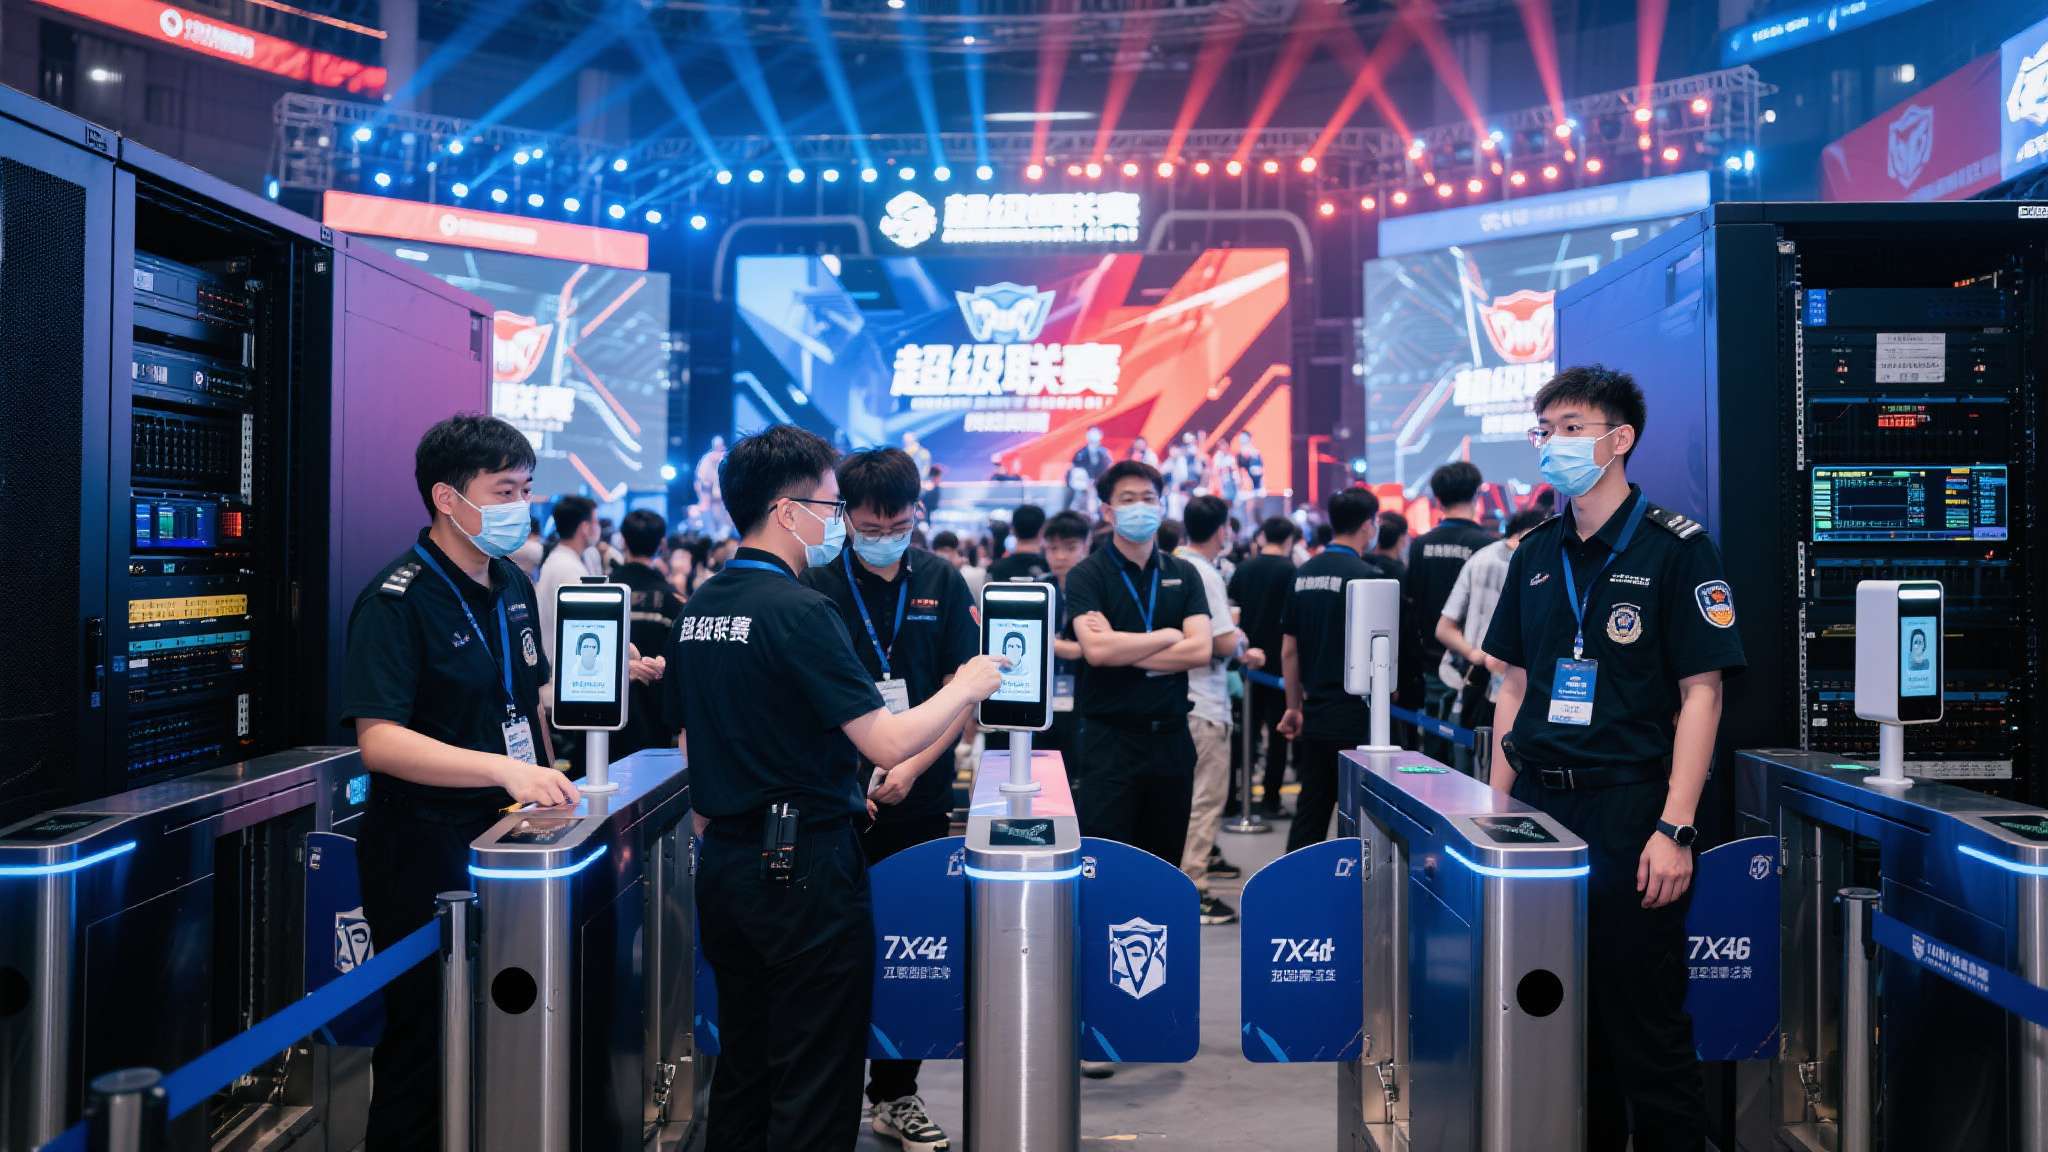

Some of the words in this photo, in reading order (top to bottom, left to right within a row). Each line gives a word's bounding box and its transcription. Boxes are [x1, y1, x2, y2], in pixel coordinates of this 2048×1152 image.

[890, 343, 1121, 396] 超级联赛
[1688, 936, 1751, 960] 7X46
